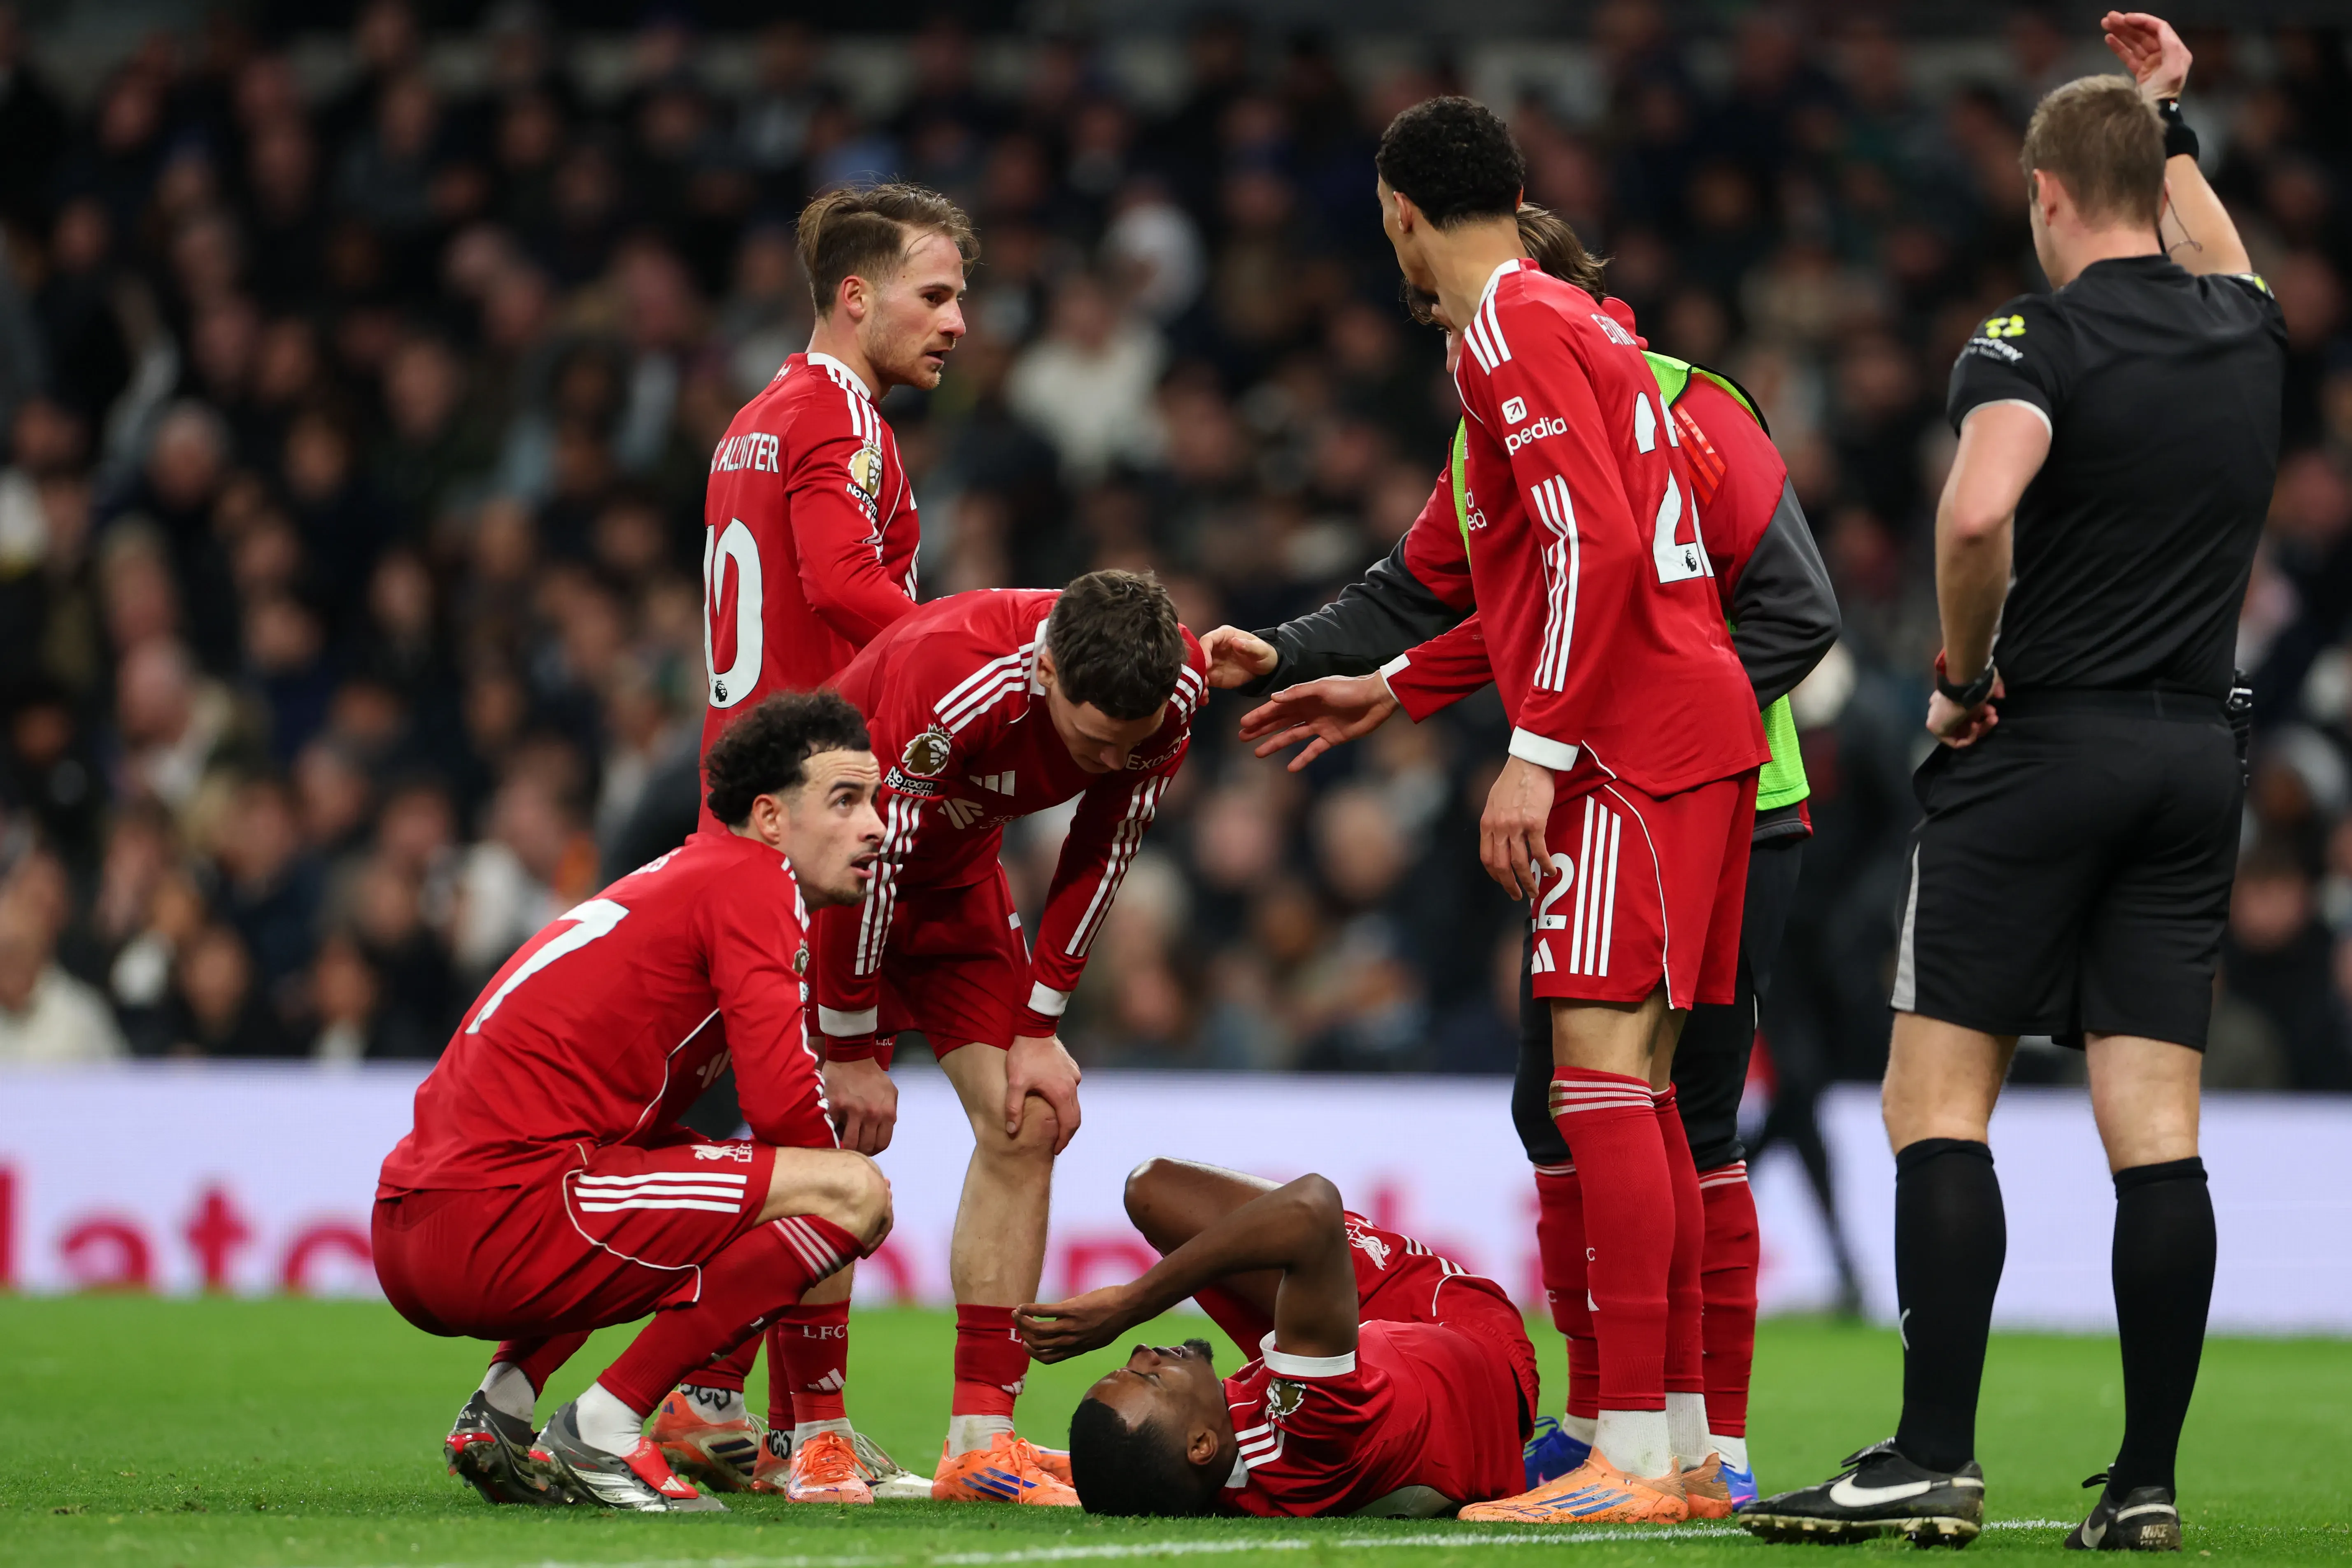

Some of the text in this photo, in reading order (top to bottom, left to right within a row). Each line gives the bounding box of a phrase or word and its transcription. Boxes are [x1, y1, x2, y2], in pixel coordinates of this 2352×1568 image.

[1504, 417, 1567, 456] pedia
[846, 483, 877, 516] No room
[703, 517, 763, 709] 10
[888, 766, 934, 790] No room
[465, 897, 630, 1034] 7
[803, 1325, 845, 1340] LFC
